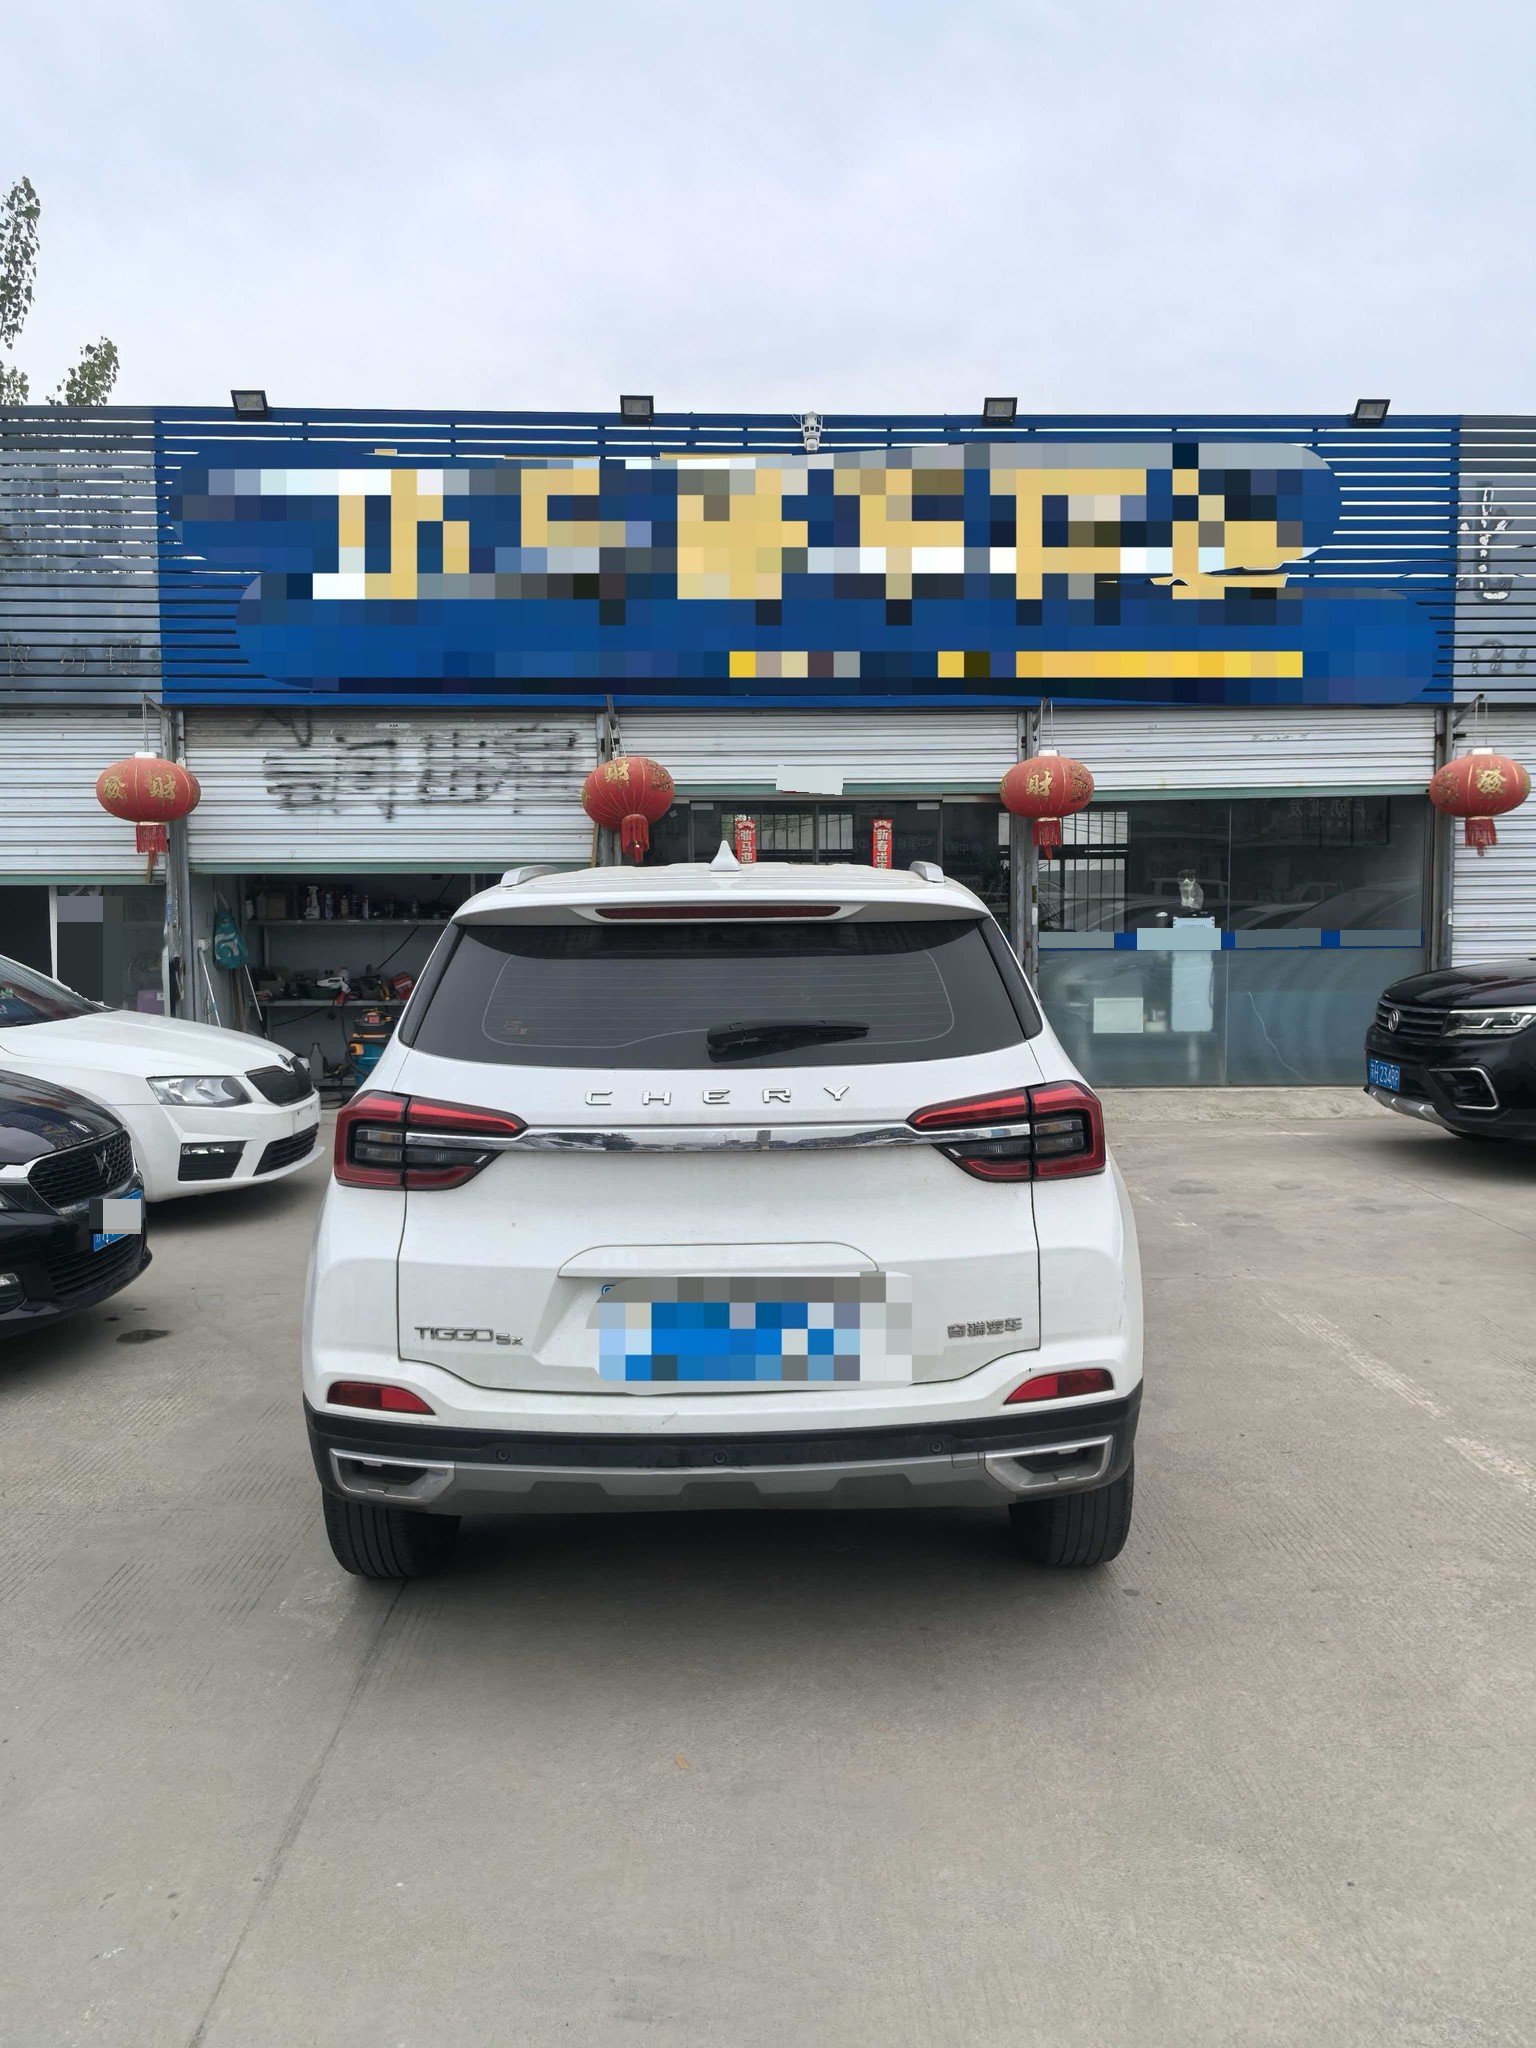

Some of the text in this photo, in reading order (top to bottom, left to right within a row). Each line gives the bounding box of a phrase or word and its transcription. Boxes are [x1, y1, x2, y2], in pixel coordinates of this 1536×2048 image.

[1026, 769, 1053, 798] 財
[585, 1085, 850, 1106] CHERY
[946, 1317, 1023, 1339] 奇瑞汽车
